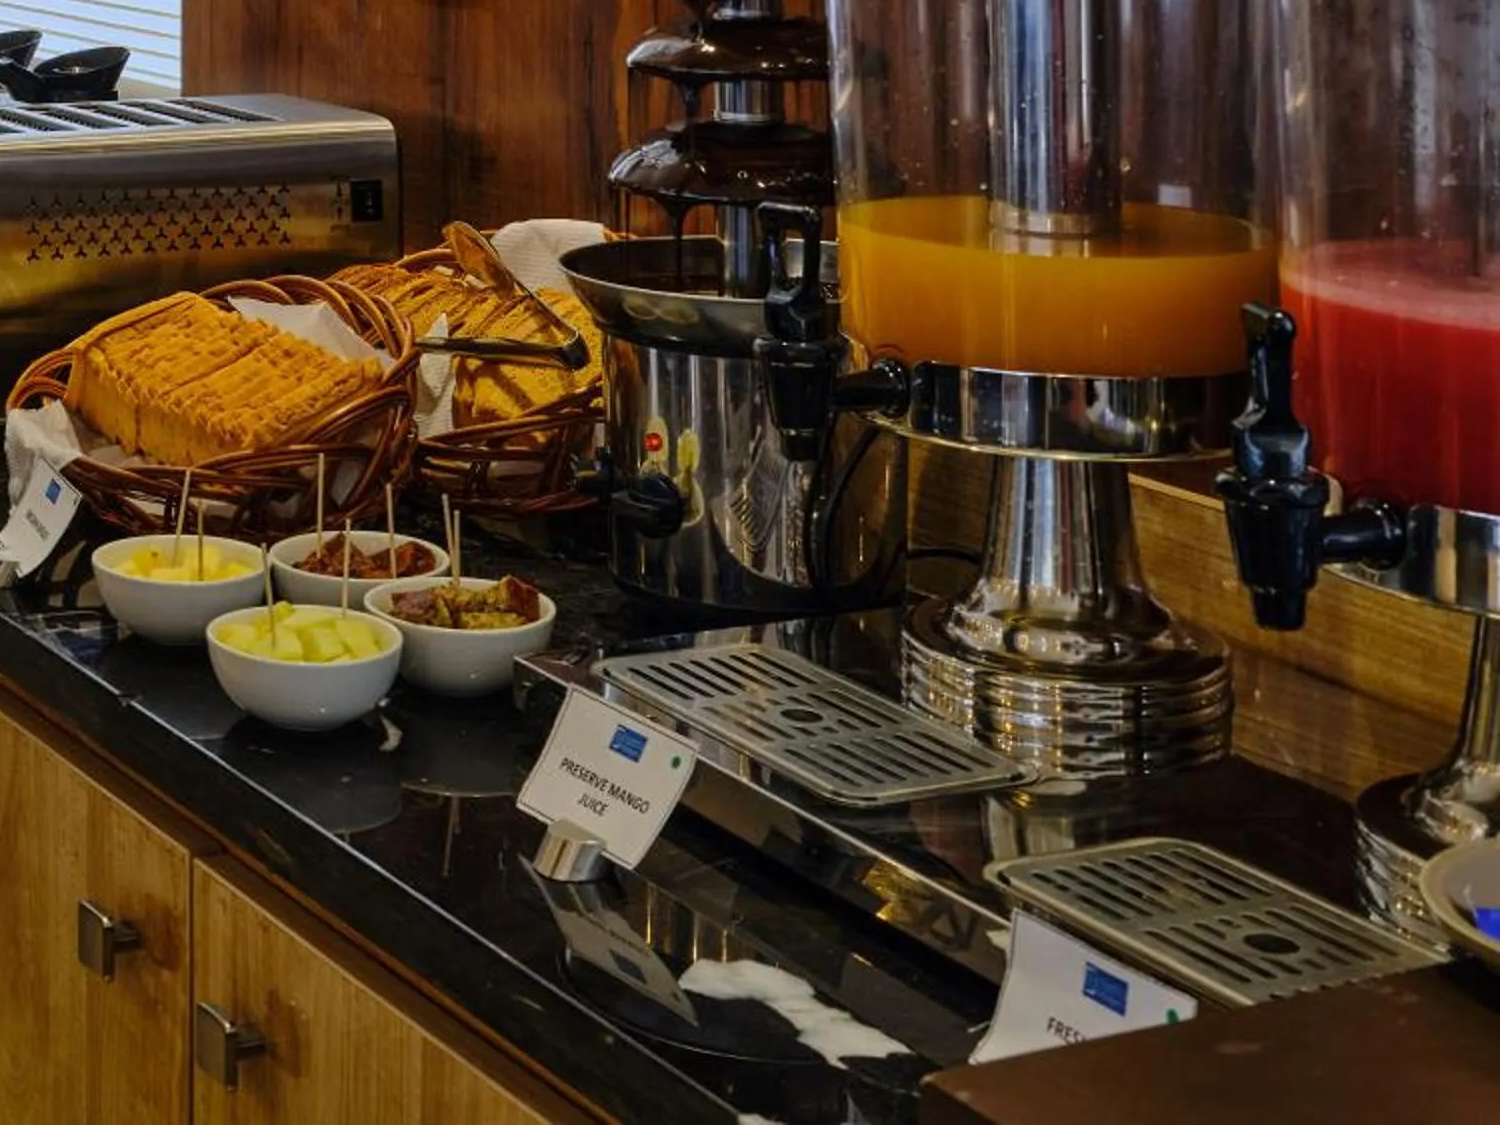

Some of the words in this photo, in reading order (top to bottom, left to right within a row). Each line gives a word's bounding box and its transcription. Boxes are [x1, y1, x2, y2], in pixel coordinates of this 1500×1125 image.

[560, 757, 608, 792] PRESERVE
[607, 783, 650, 814] MANGO
[578, 793, 608, 816] JUICE
[1046, 1017, 1086, 1046] FRES
